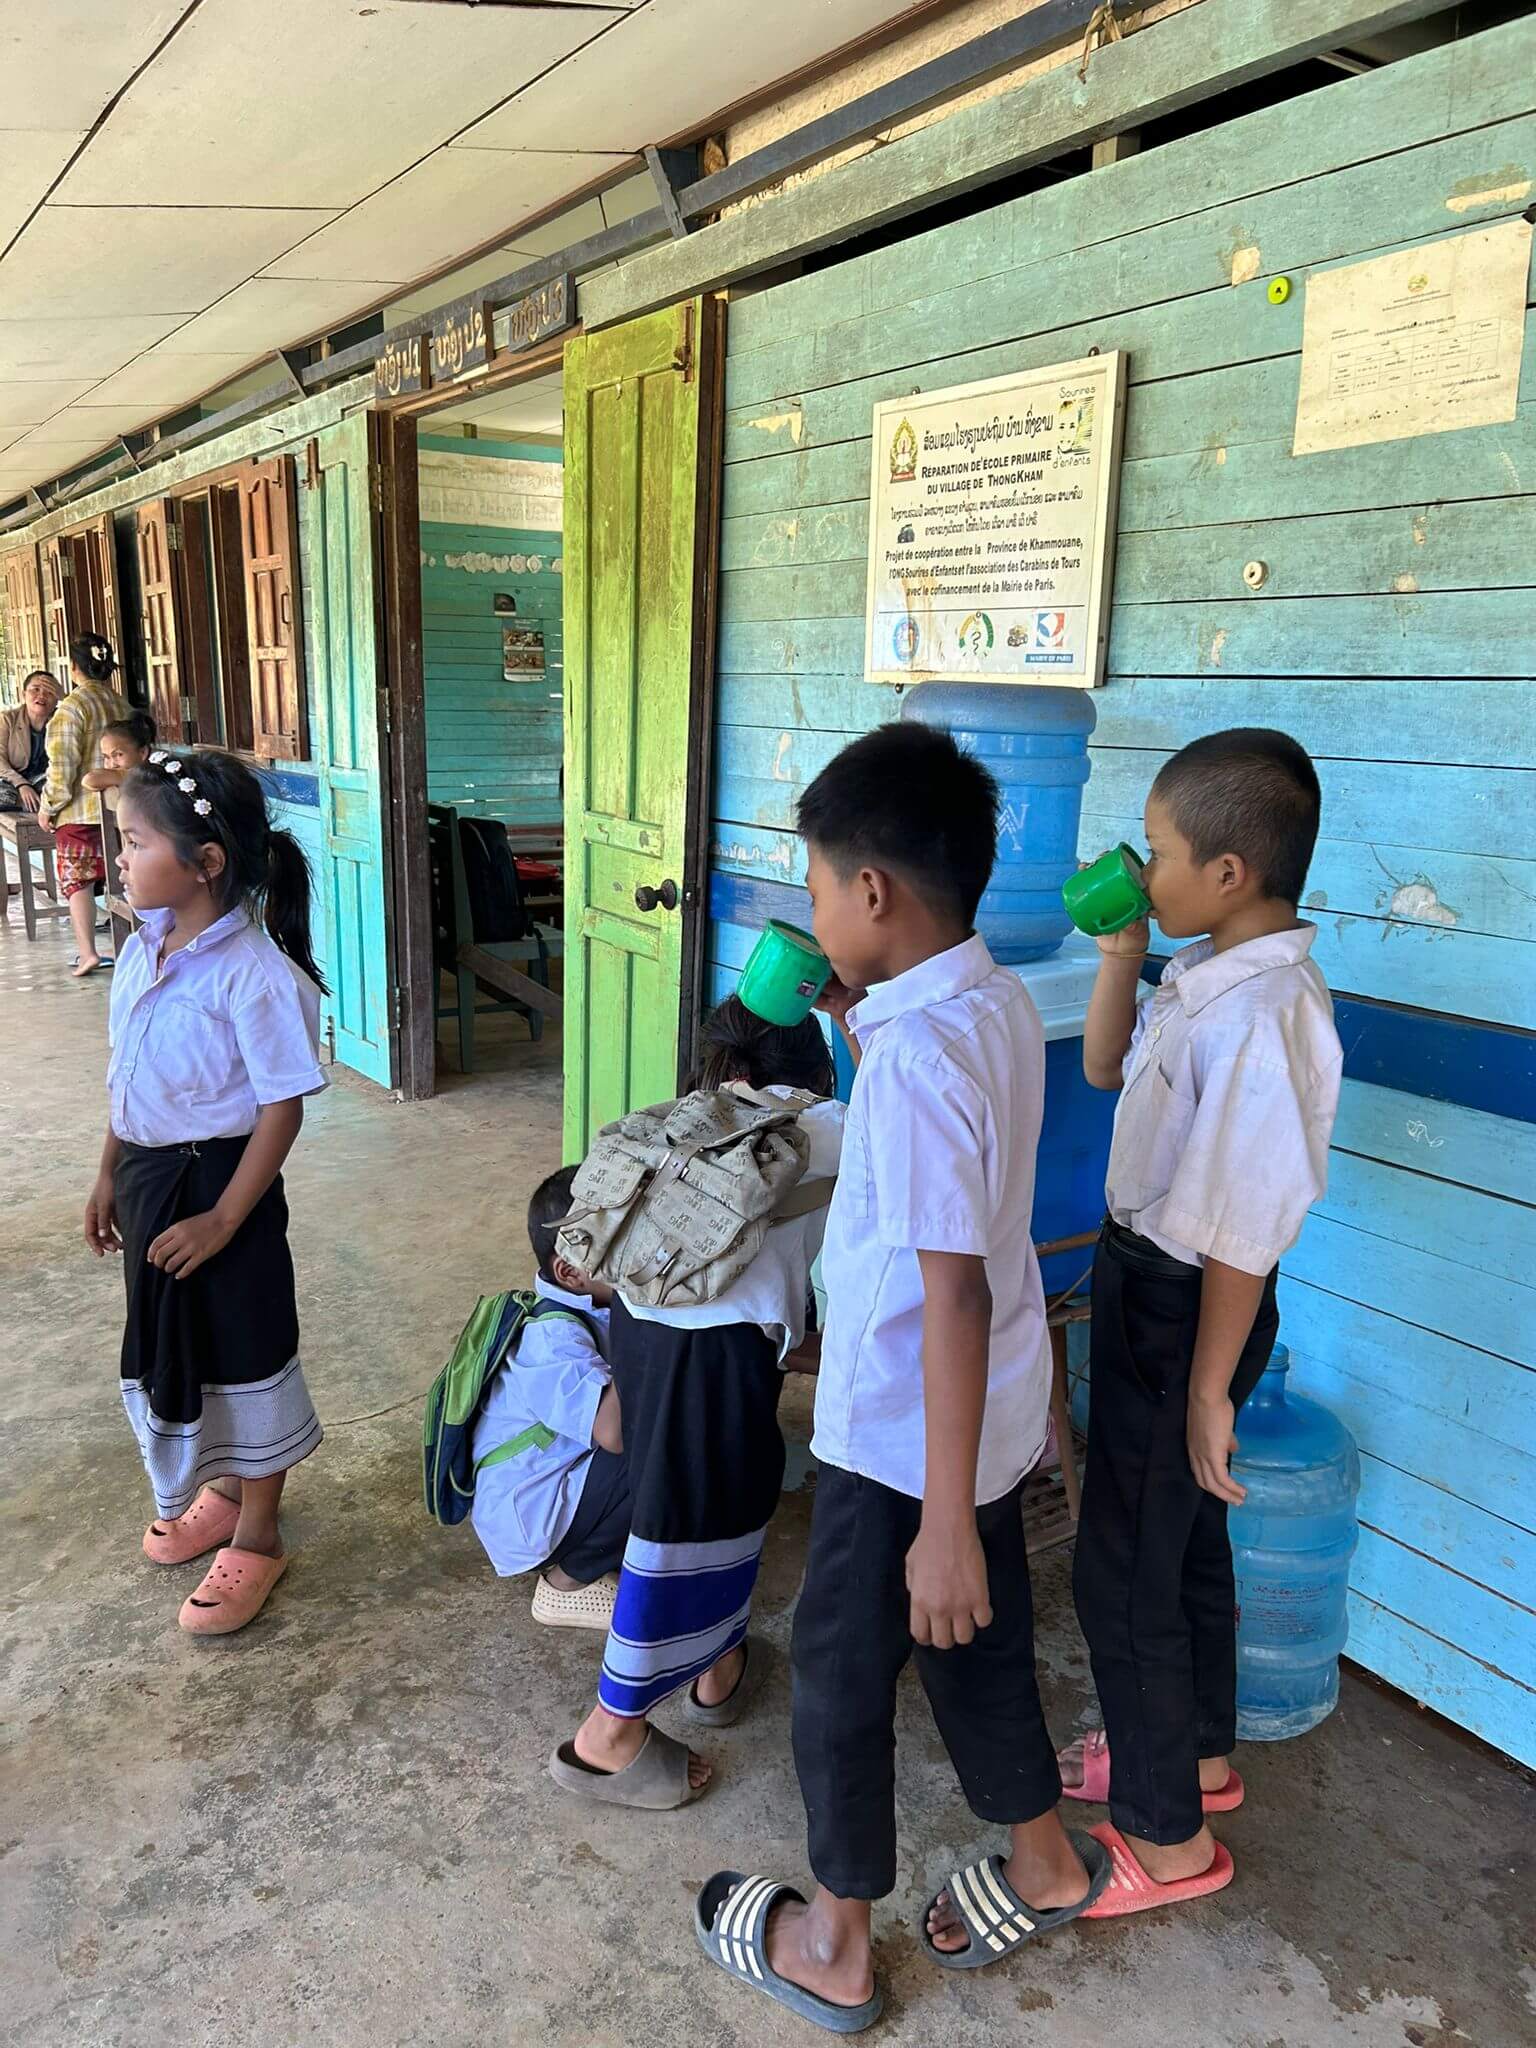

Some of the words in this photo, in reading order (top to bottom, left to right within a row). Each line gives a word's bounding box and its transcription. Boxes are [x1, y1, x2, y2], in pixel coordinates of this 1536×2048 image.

[1010, 449, 1052, 467] PRIMAIRE
[927, 484, 938, 495] DU
[939, 479, 971, 493] VILLAGE
[973, 477, 984, 489] DE
[885, 550, 904, 563] Projet
[905, 549, 914, 560] de
[914, 545, 953, 561] coopération
[954, 545, 973, 557] entre
[974, 543, 981, 555] la
[987, 542, 1017, 554] Province
[1018, 539, 1028, 551] de
[1029, 537, 1083, 551] Khammouane,
[1007, 560, 1019, 573] des
[1020, 559, 1049, 572] Carabins
[1050, 557, 1060, 570] de
[1061, 556, 1081, 569] Tours
[930, 582, 981, 596] cofinancement
[982, 581, 991, 593] de
[992, 580, 999, 592] la
[1001, 580, 1022, 593] Mairie
[1024, 579, 1033, 591] de
[1035, 577, 1056, 591] Paris.
